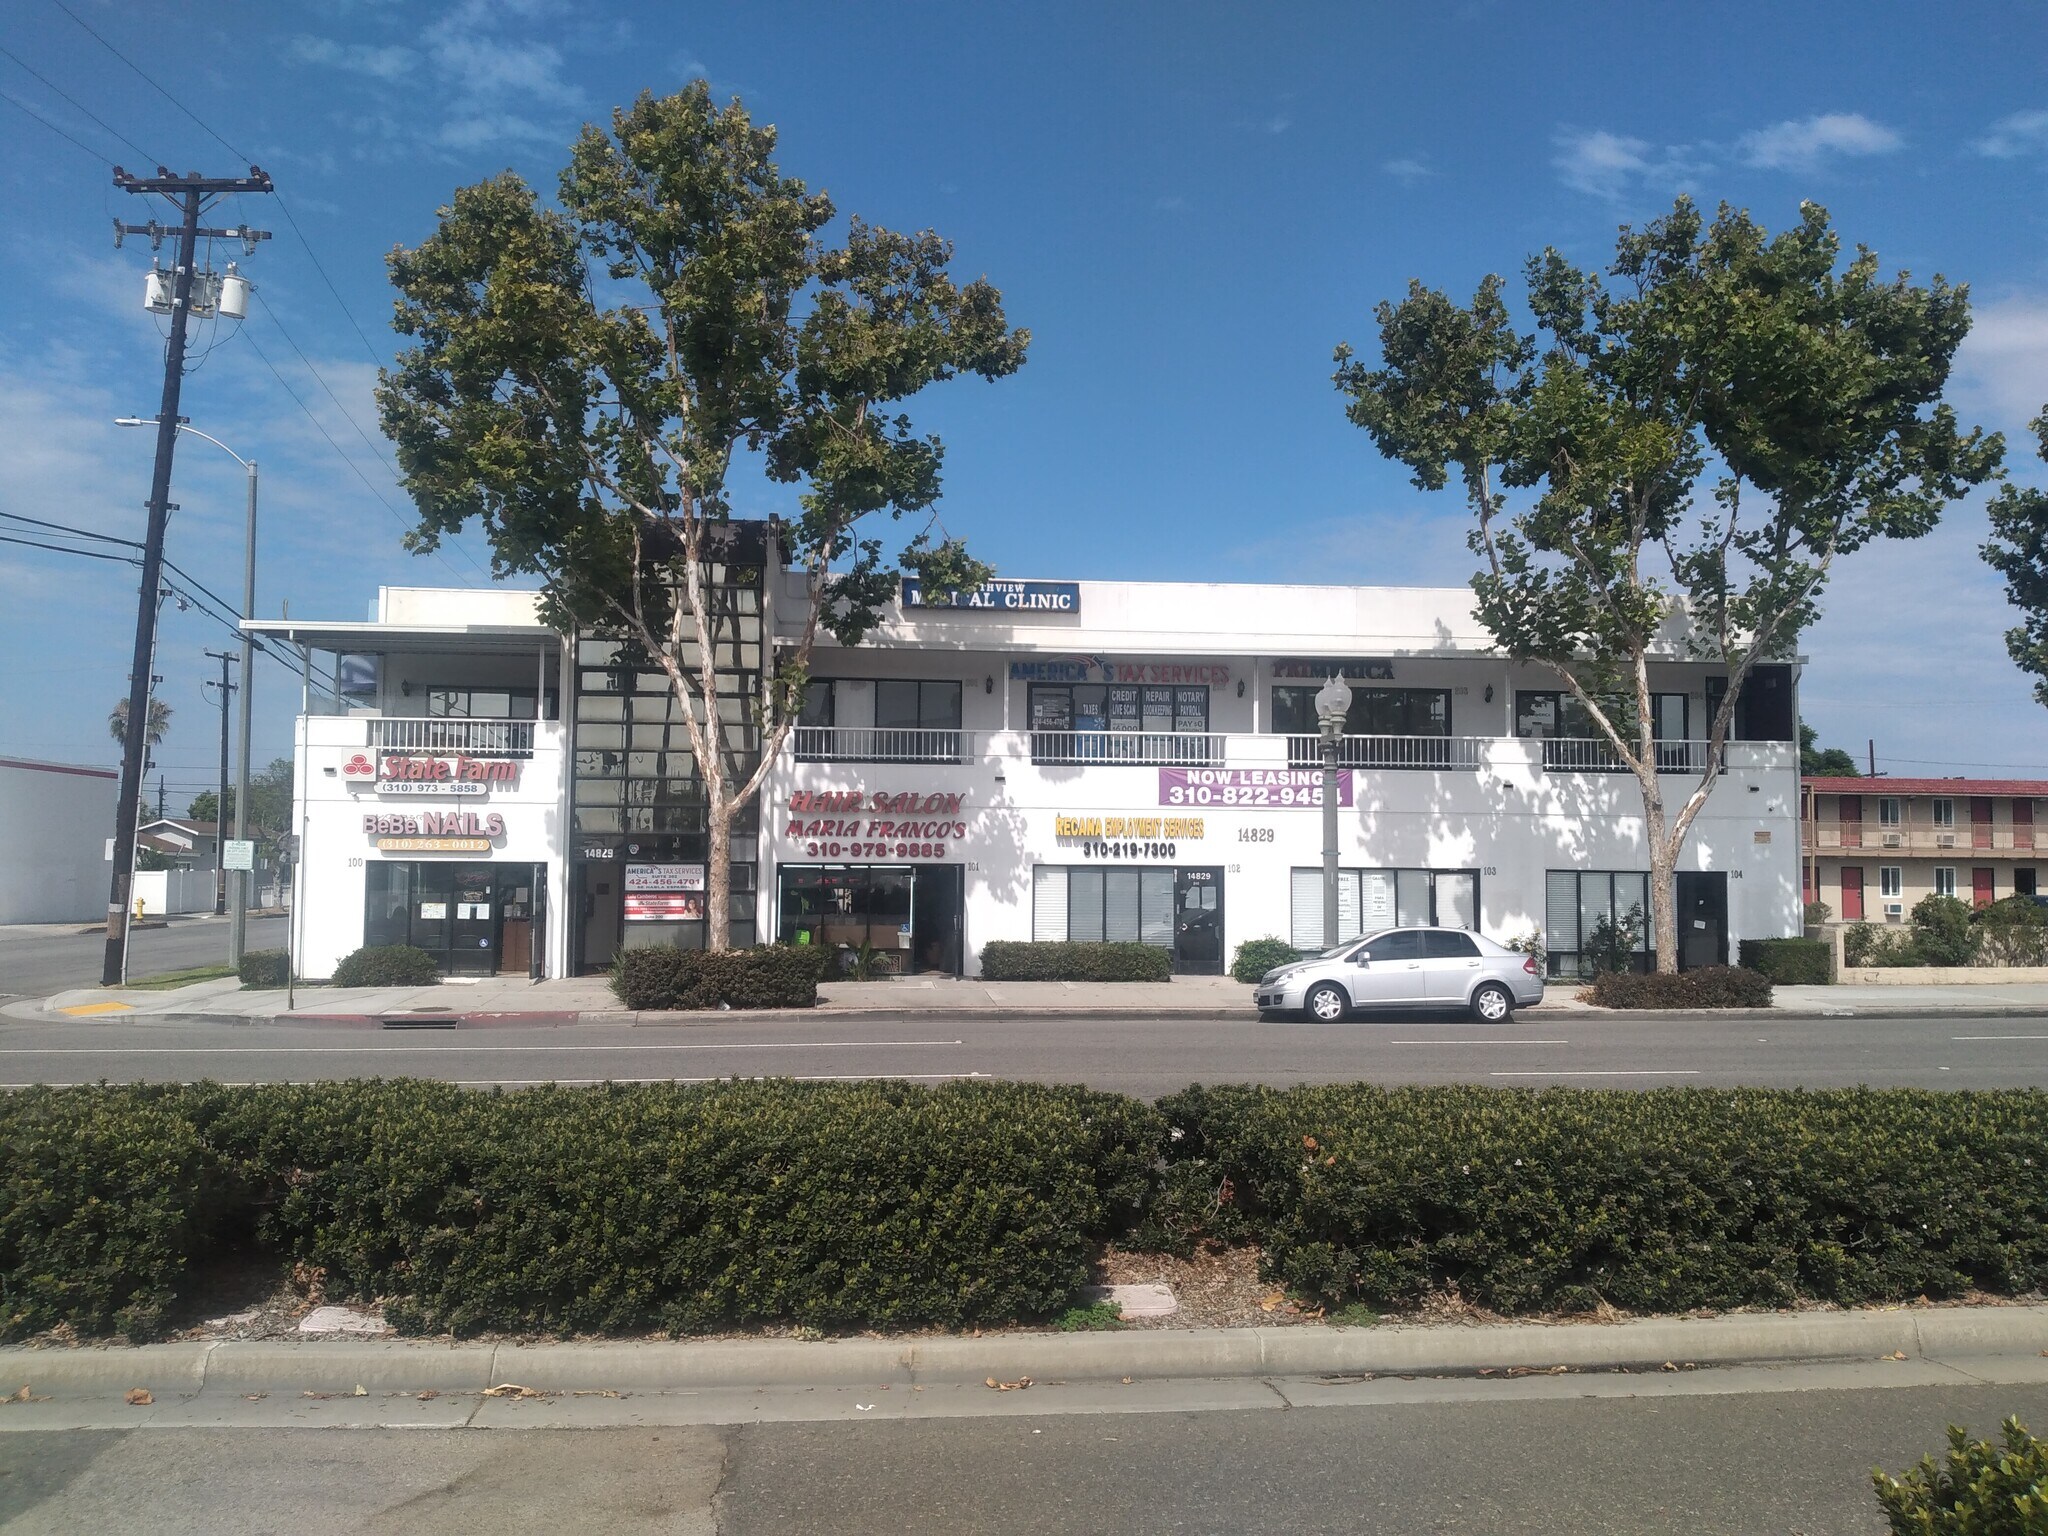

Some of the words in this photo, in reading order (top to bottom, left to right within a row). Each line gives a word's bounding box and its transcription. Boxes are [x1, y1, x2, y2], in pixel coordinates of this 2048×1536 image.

[911, 590, 995, 608] MIAL
[1005, 592, 1071, 610] CLINIC
[1115, 664, 1147, 683] TAX
[1149, 665, 1231, 685] SERVICES
[1111, 690, 1137, 702] CREDIT
[1145, 691, 1170, 702] REPAIR
[1177, 691, 1205, 703] NOTARY
[1082, 703, 1099, 716] TAXES
[1112, 704, 1123, 715] LIVE
[1123, 704, 1136, 715] SCAN
[1143, 704, 1173, 716] BOOKKEEPING
[1180, 704, 1201, 716] PAYROLL
[1177, 720, 1193, 728] PAY
[382, 755, 449, 781] State
[455, 755, 517, 781] Farm
[1187, 770, 1232, 785] NOW
[1240, 770, 1324, 786] LEASING
[382, 783, 412, 793] (310)
[417, 784, 438, 793] 973
[449, 784, 478, 793] 5858
[788, 790, 864, 813] HAIR
[868, 791, 967, 815] SALON
[363, 814, 417, 834] BeBe
[422, 811, 505, 836] NAILS
[784, 819, 861, 838] MARIA
[866, 820, 967, 839] FRANCO'S
[1055, 815, 1103, 837] RECANA
[1104, 817, 1162, 840] EMPLOYMENT
[1163, 817, 1205, 841] SERVICES
[1237, 828, 1275, 843] 14829
[382, 839, 413, 849] (310)
[806, 842, 946, 858] 310-978-9885
[1083, 841, 1177, 858] 310-219-7300
[584, 848, 614, 858] 14829
[348, 857, 363, 867] 100
[967, 862, 980, 872] 101
[1227, 863, 1241, 873] 102
[663, 867, 674, 875] TAX
[674, 867, 703, 875] SERVICES
[1187, 872, 1211, 880] 14829
[1483, 867, 1497, 876] 103
[1730, 869, 1743, 879] 104
